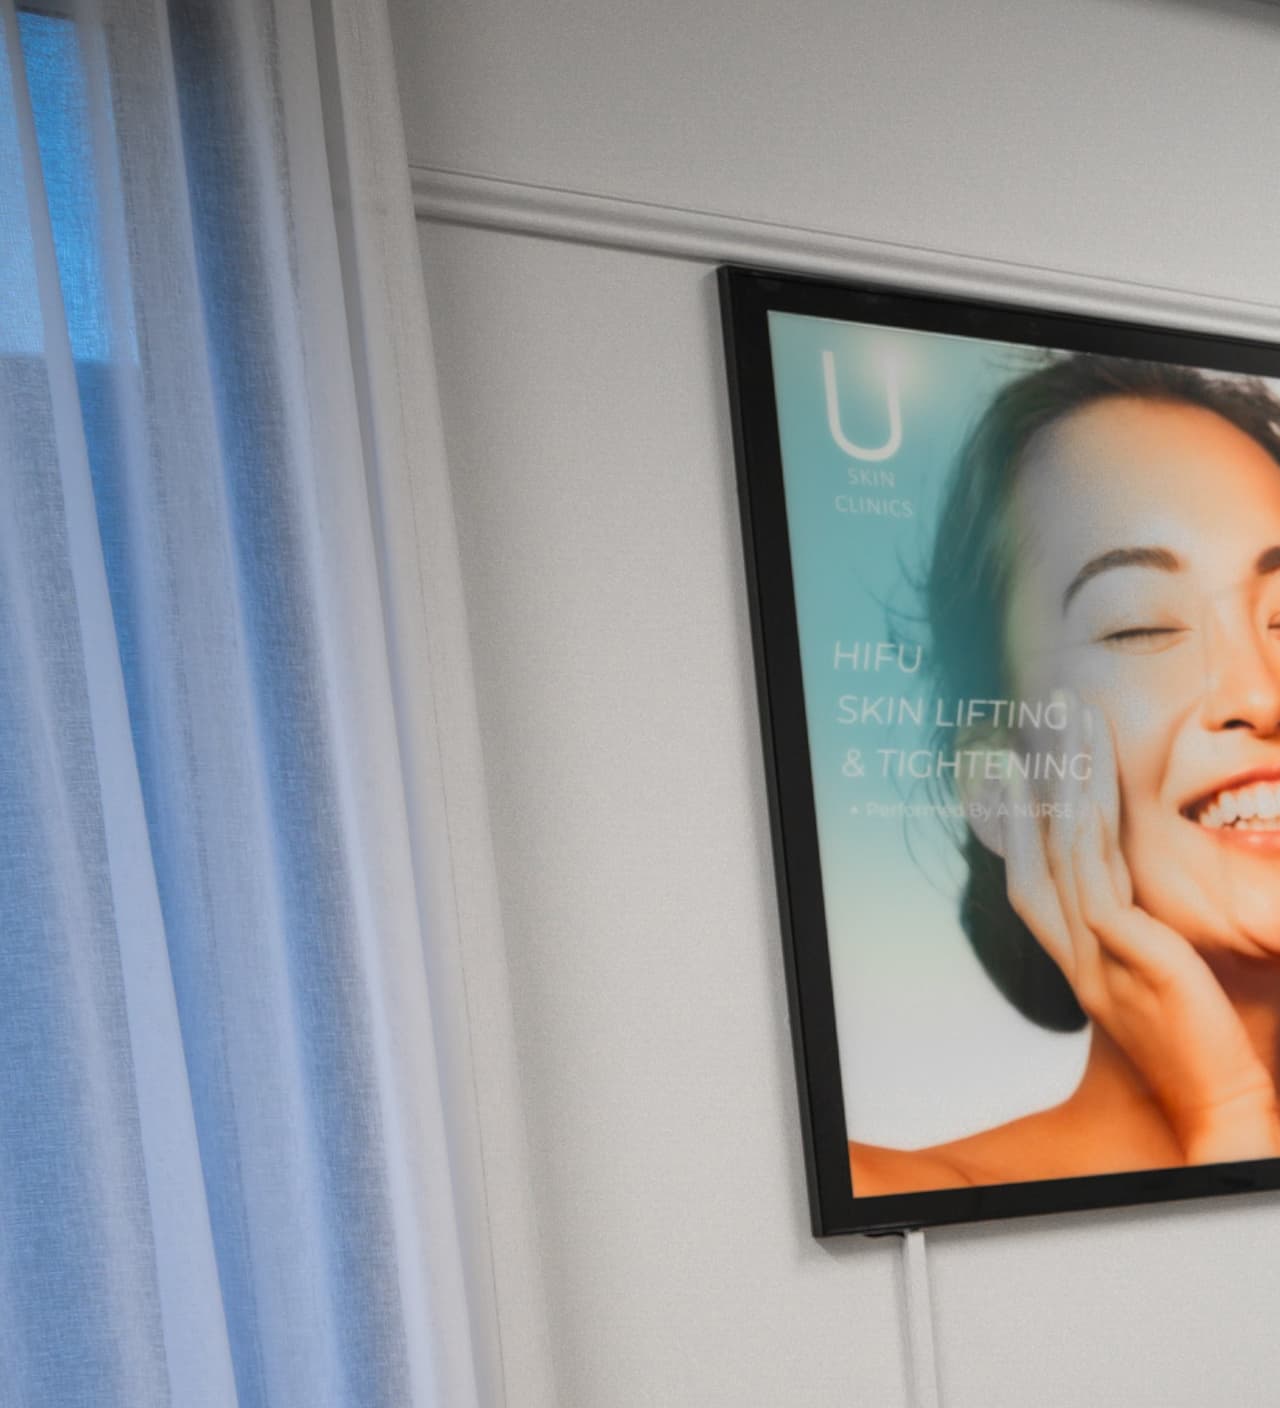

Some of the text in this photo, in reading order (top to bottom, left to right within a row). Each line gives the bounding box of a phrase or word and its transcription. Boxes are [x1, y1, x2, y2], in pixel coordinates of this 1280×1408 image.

[822, 350, 903, 461] U
[847, 467, 896, 488] SKIN
[834, 495, 913, 518] CLINICS
[833, 640, 922, 674] HIFU
[837, 695, 1068, 731] SKIN LIFTING
[841, 748, 1093, 781] & TIGHTENING
[970, 802, 992, 820] By
[996, 802, 1011, 818] A
[1013, 802, 1073, 819] NURSE
